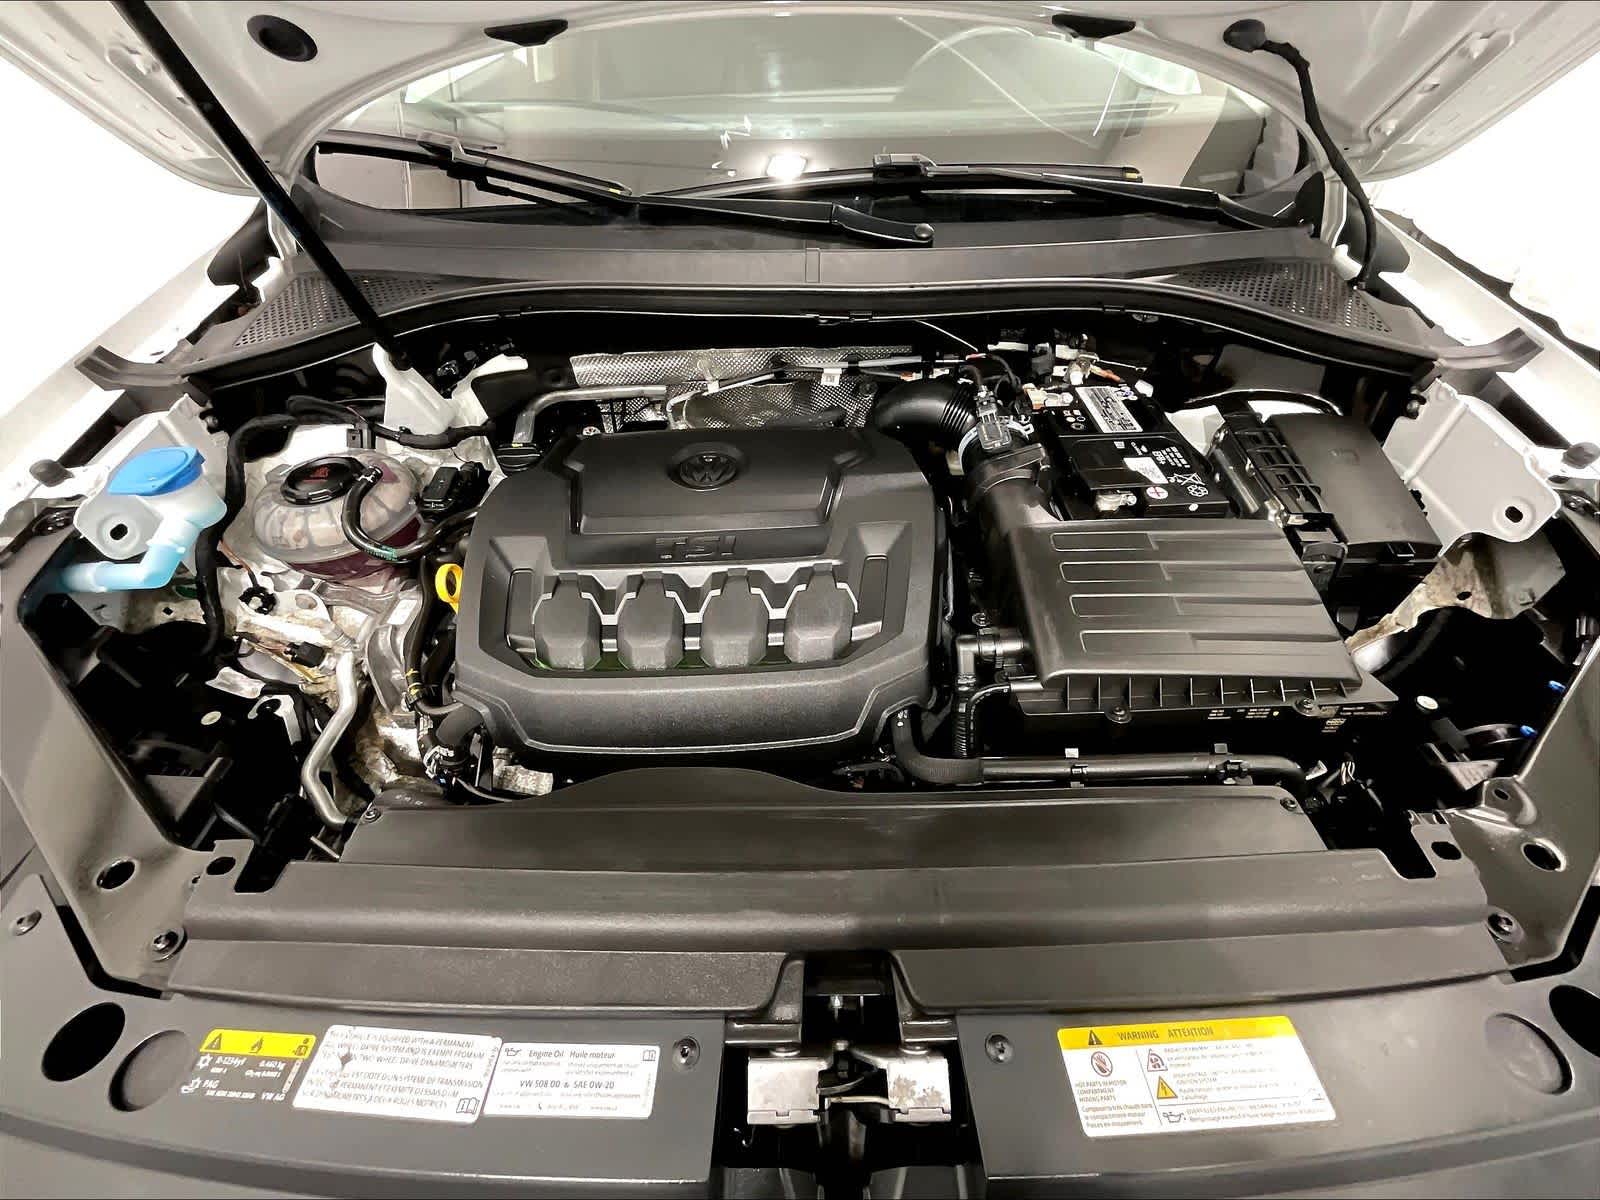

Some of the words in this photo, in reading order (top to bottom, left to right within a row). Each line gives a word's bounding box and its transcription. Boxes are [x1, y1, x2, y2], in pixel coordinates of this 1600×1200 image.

[655, 535, 737, 559] TSI
[1117, 1030, 1159, 1041] WARNING
[1168, 1027, 1214, 1038] ATTENTION
[528, 1049, 552, 1060] Engine
[554, 1050, 564, 1058] Oil
[570, 1050, 588, 1058] Huile
[589, 1051, 616, 1059] moteur
[202, 1079, 220, 1088] PAG
[520, 1080, 533, 1088] VW
[535, 1080, 549, 1088] 508
[550, 1080, 561, 1088] 00
